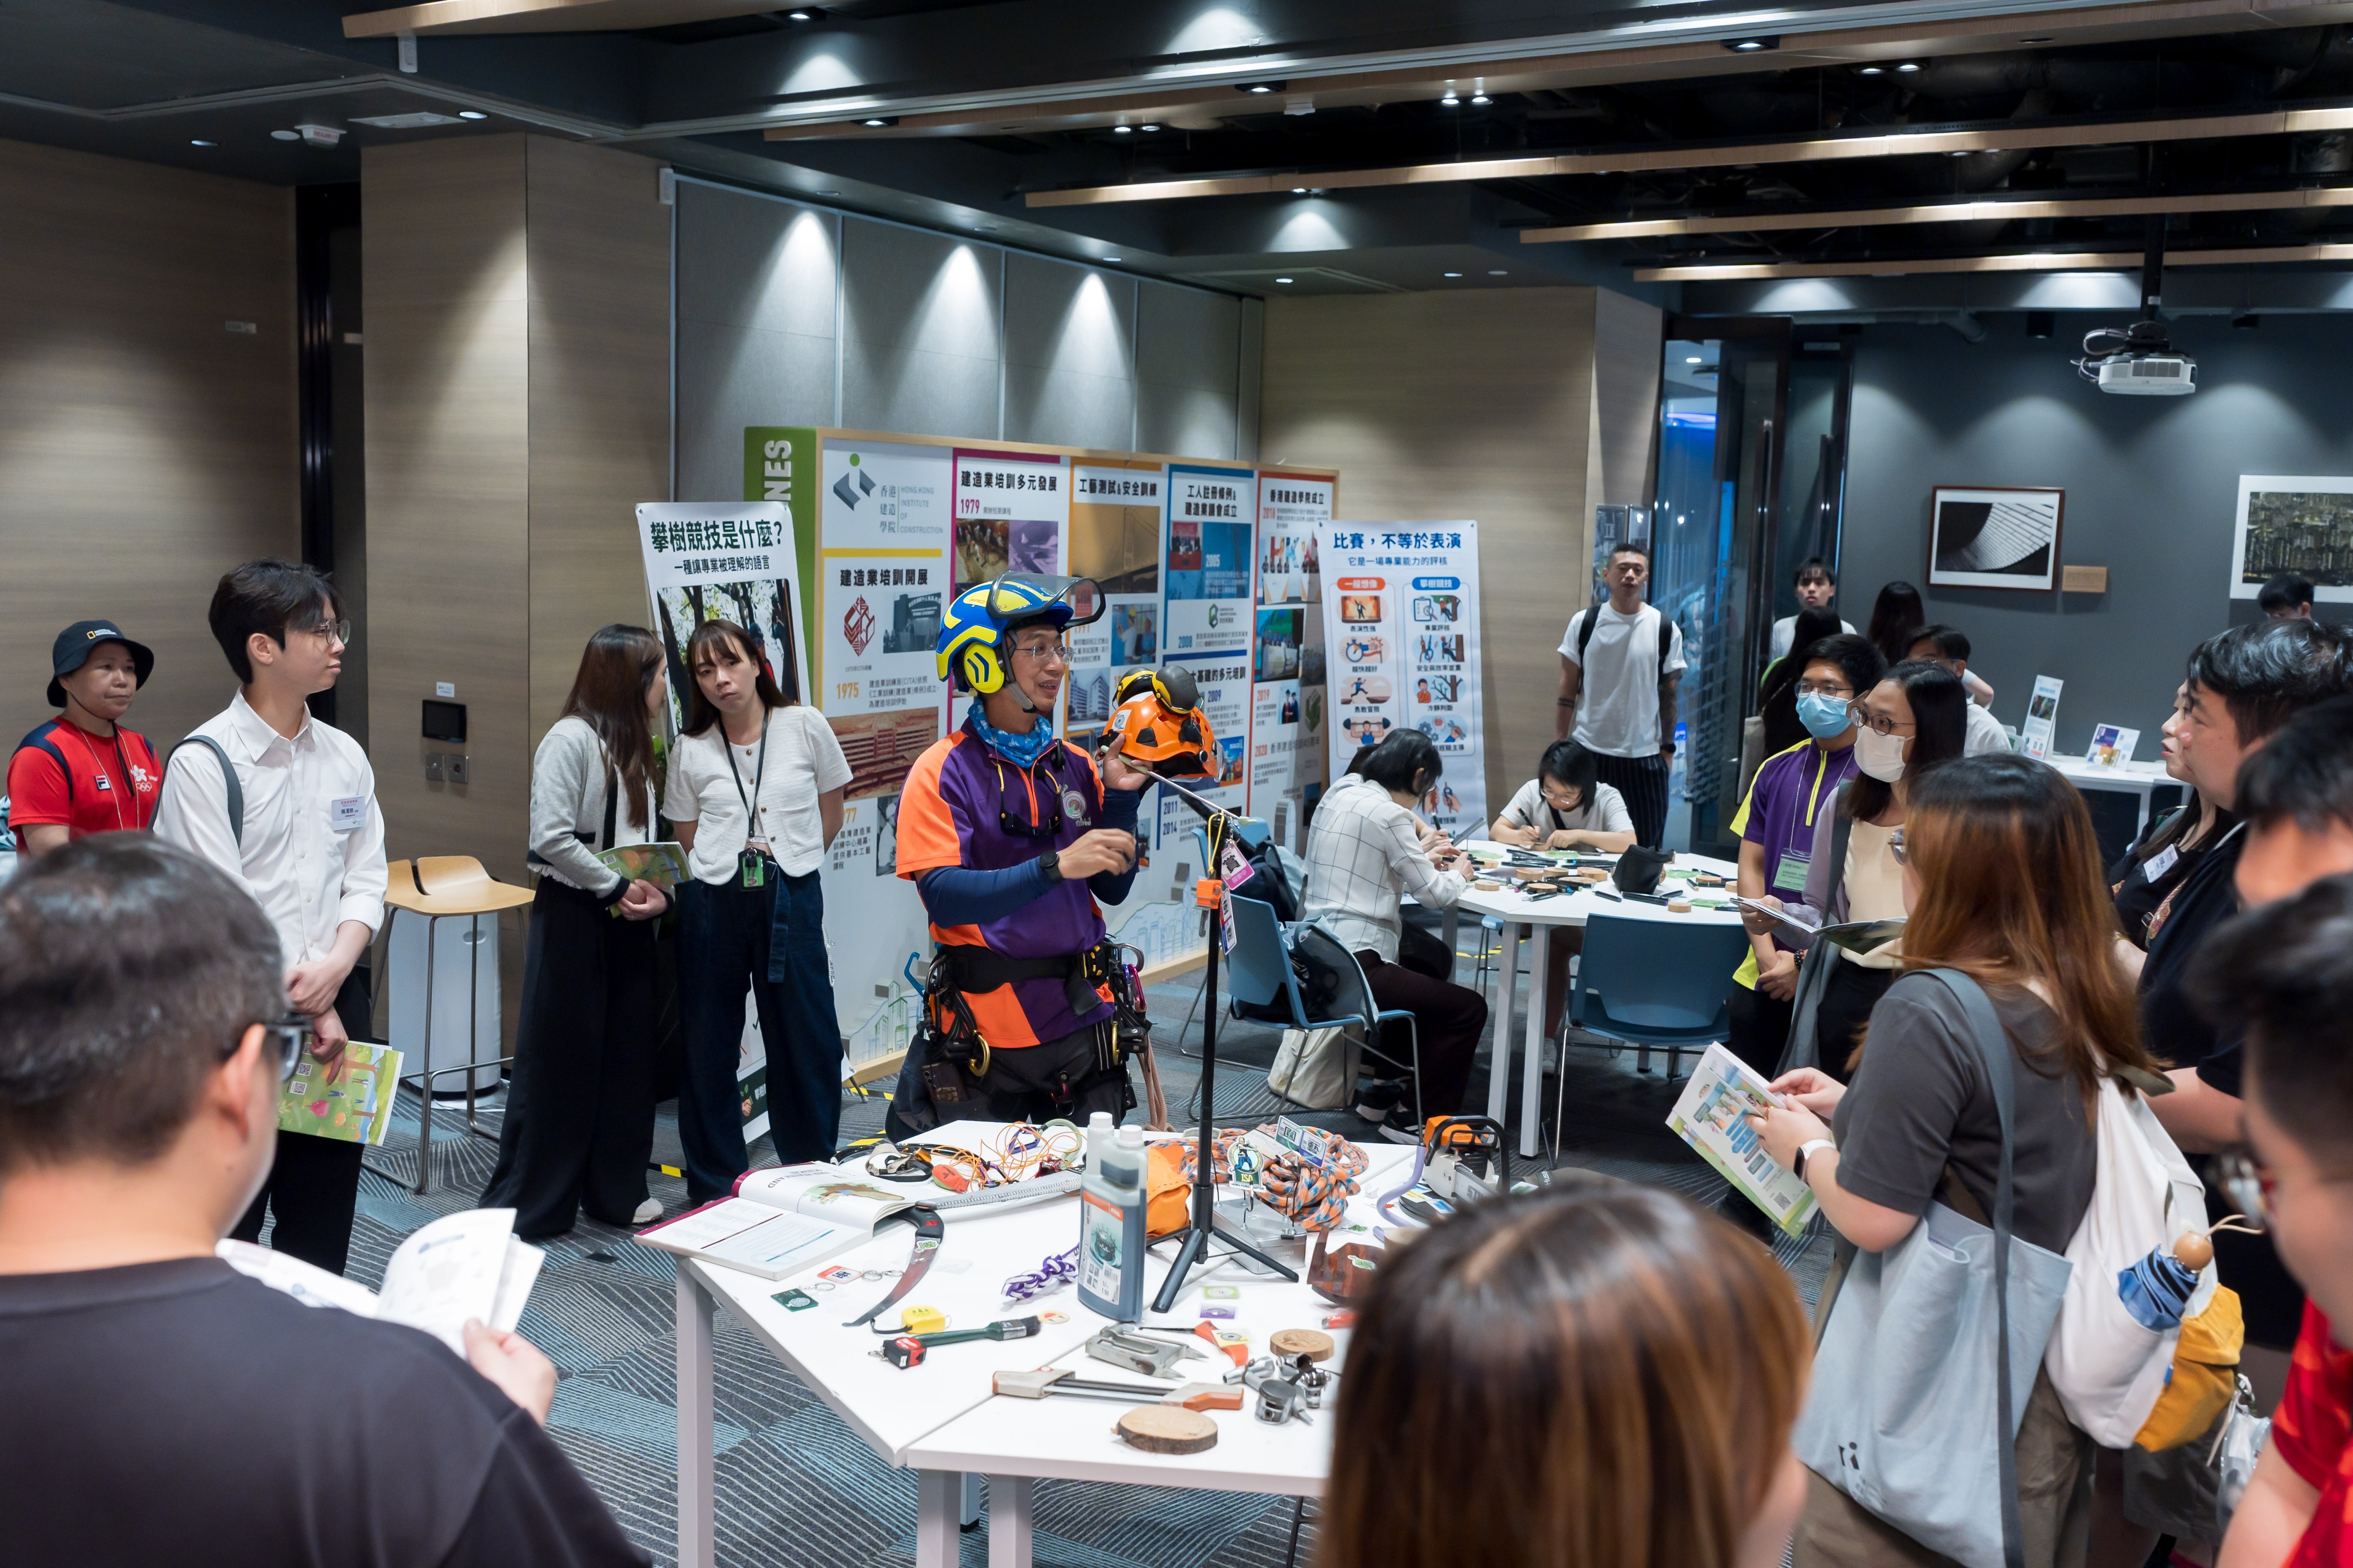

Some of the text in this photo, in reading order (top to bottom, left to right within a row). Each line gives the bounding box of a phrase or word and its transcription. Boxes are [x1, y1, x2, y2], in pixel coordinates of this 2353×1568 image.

[961, 470, 1057, 492] 建造業培訓多元發展
[881, 485, 896, 498] 香港
[880, 503, 896, 515] 建造
[901, 499, 929, 508] INSTITUTE
[961, 499, 979, 514] 1979
[879, 521, 896, 534] 學院
[900, 526, 943, 534] CONSTRUCTION
[1333, 533, 1461, 549] 比賽，不等於表演
[674, 555, 770, 575] 一種讓專業被理解的語言
[1348, 557, 1448, 566] 它是一場專業能力的評核
[840, 569, 928, 587] 建造業培訓開展
[837, 682, 859, 700] 1975
[1164, 800, 1178, 815] 2011
[843, 807, 857, 824] 77
[1163, 821, 1177, 835] 2014
[768, 1177, 785, 1188] AND
[1241, 1174, 1253, 1182] ISA
